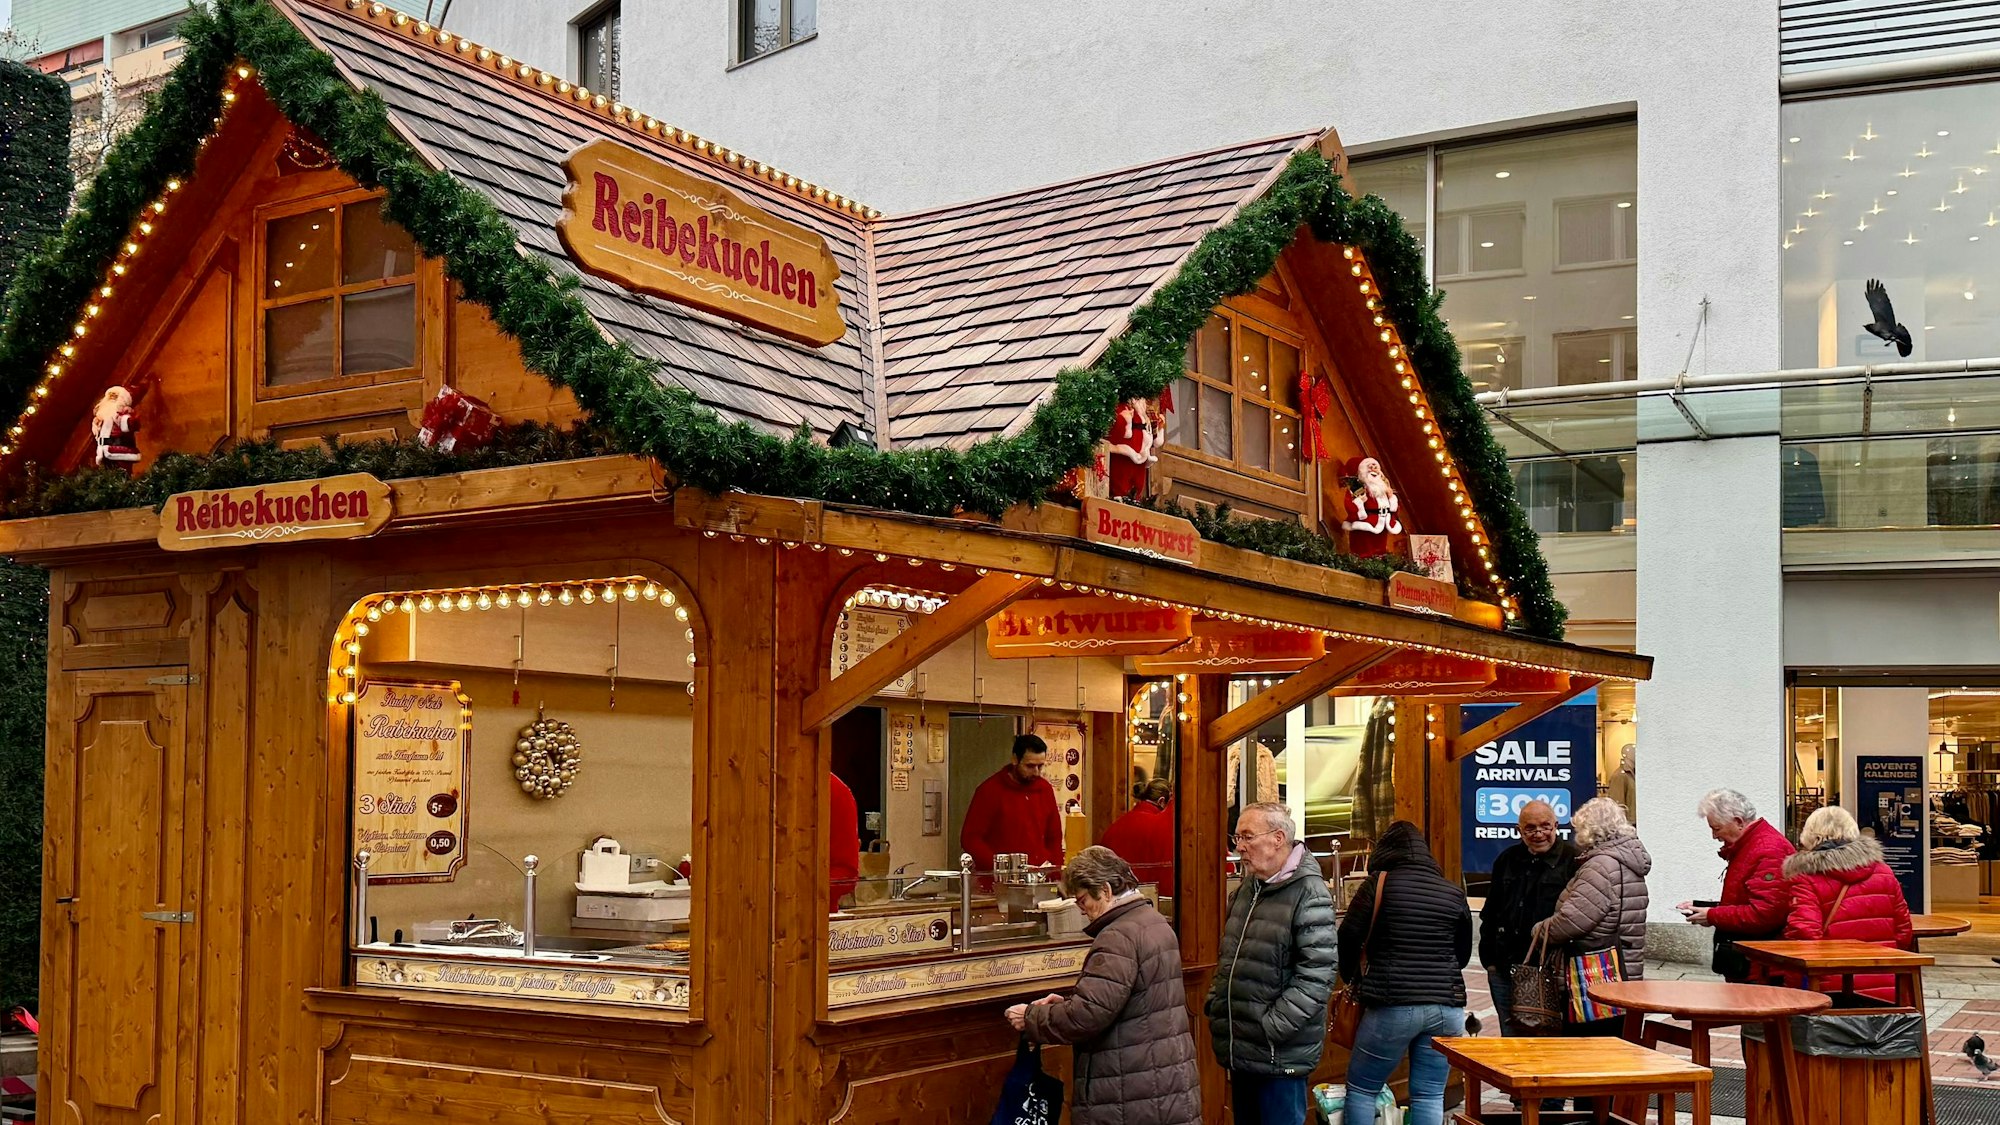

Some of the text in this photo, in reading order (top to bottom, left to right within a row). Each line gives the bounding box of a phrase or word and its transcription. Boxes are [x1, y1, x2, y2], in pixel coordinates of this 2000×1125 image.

[592, 171, 817, 308] Reibekuchen
[175, 484, 369, 532] Reibekuchen
[1097, 508, 1194, 556] Bratwurst
[996, 607, 1179, 637] Bratwurst
[363, 713, 458, 741] Reibekuchen
[1475, 741, 1571, 765] SALE
[1864, 762, 1918, 770] ADVENTS
[1476, 768, 1571, 781] ARRIVALS
[1864, 771, 1918, 779] KALENDER
[359, 794, 375, 815] 3
[378, 792, 416, 815] Stück
[430, 838, 450, 849] 0,50
[829, 929, 883, 951] Reibekuchen
[888, 926, 899, 944] 3
[901, 923, 926, 943] Stück
[435, 963, 616, 998] Reibekuchen aus frischen Kartoffeln
[853, 975, 907, 996] Reibekuchen
